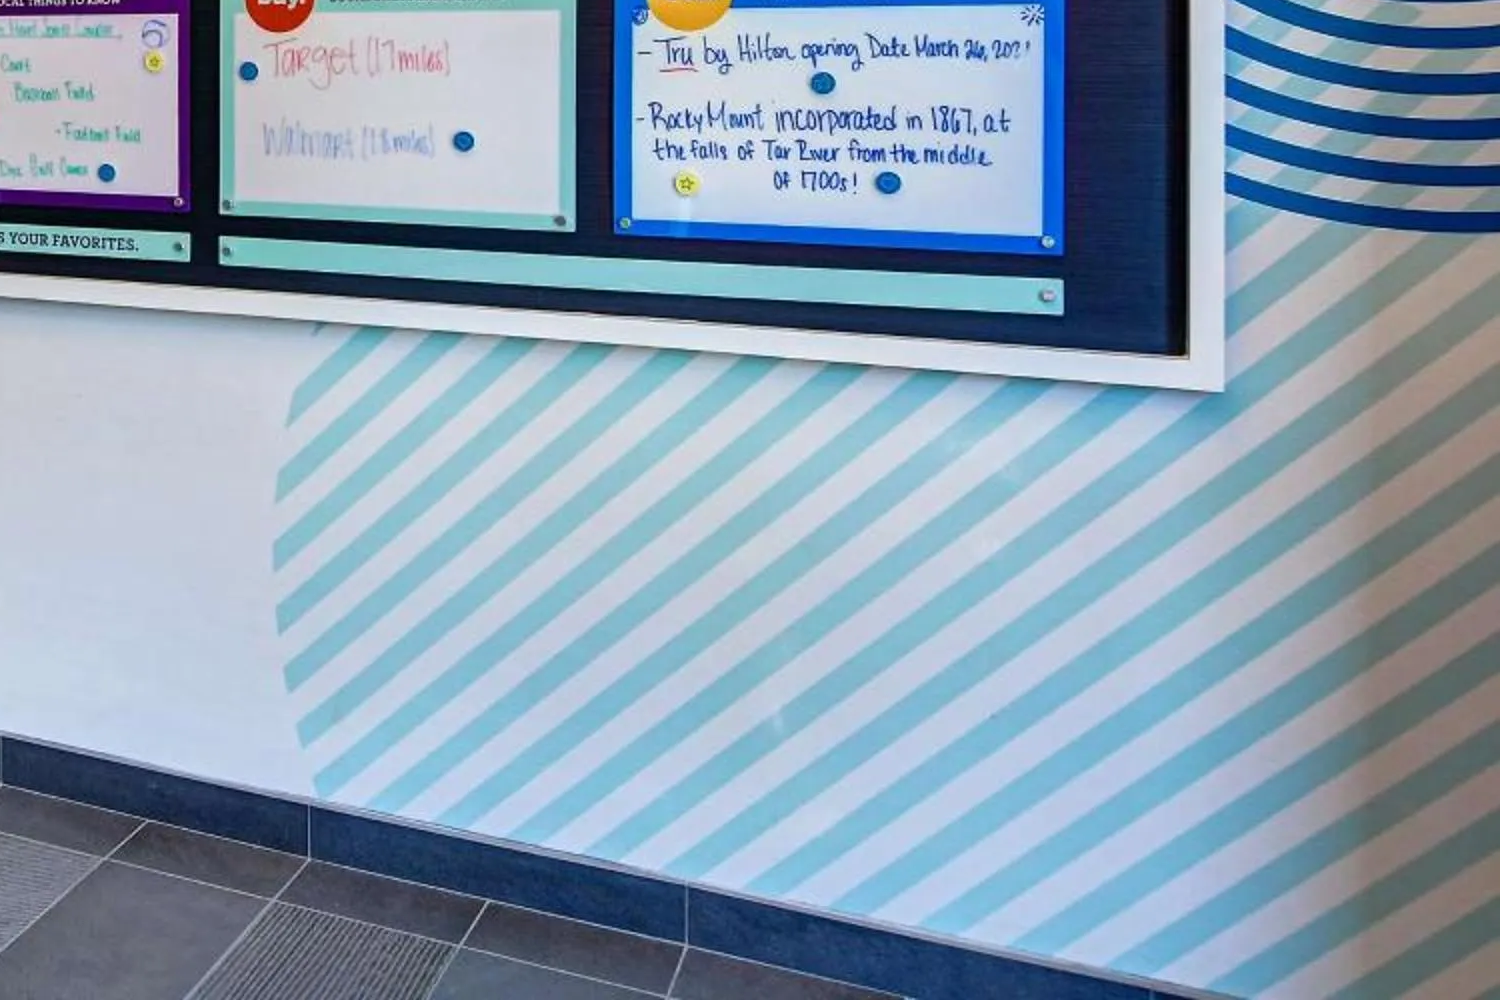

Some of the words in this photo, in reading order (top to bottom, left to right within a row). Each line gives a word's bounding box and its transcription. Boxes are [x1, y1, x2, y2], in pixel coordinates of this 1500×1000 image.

[263, 38, 359, 90] Target
[653, 37, 694, 66] Tru
[703, 38, 734, 74] by
[737, 32, 797, 62] Hilton
[801, 36, 862, 71] opening
[865, 33, 910, 58] Date
[914, 33, 959, 57] March
[648, 101, 702, 134] Rocky
[774, 101, 897, 136] incorporated
[906, 114, 923, 131] in
[983, 108, 1011, 133] at
[652, 139, 687, 161] the
[691, 137, 728, 161] falls
[737, 138, 755, 161] of
[764, 139, 794, 161] Tar
[848, 139, 887, 163] from
[888, 141, 920, 164] the
[923, 141, 994, 166] middle
[9, 232, 49, 246] YOUR
[52, 234, 139, 251] FAVORITES.
